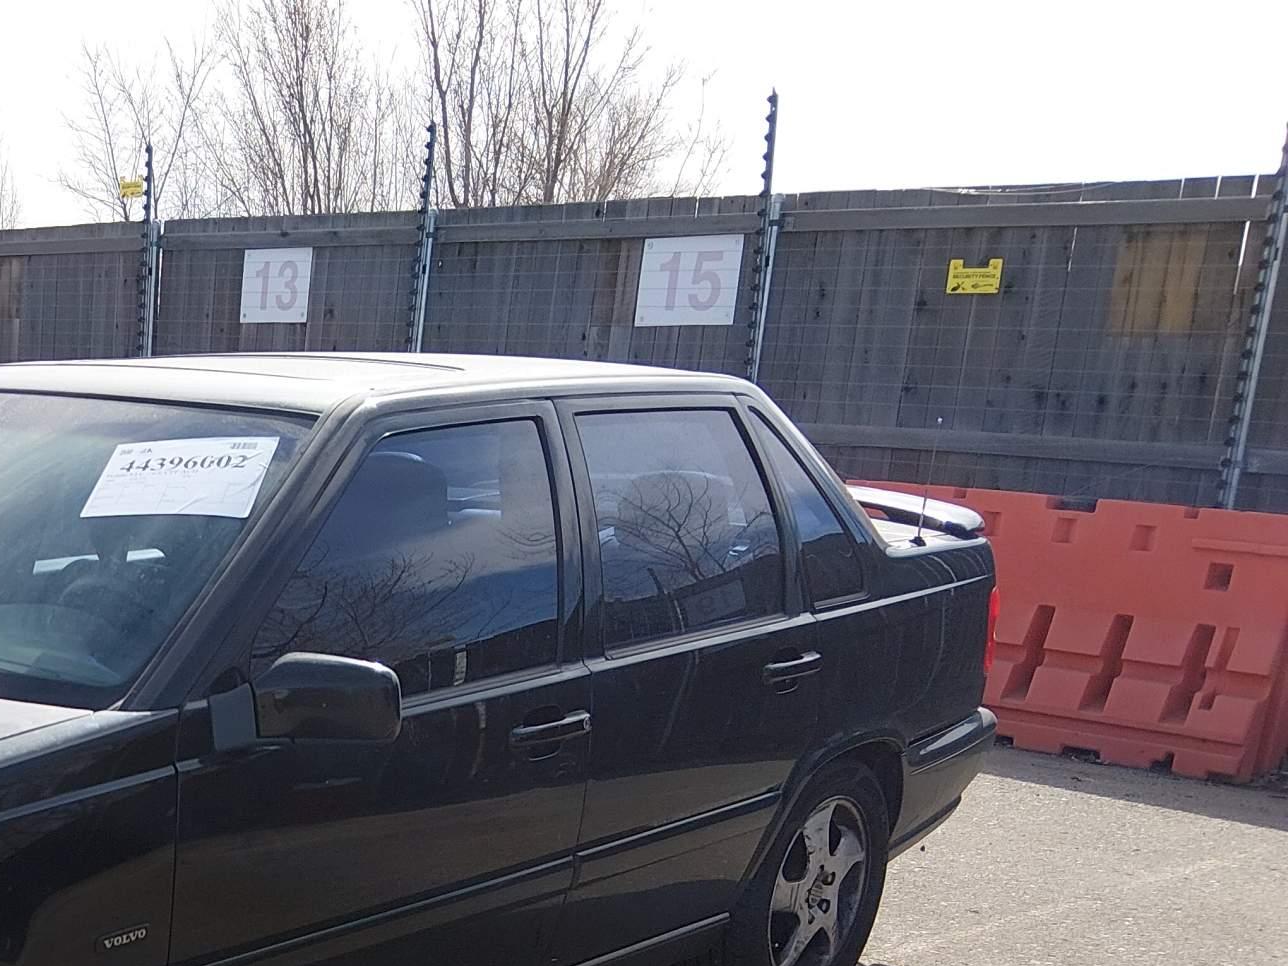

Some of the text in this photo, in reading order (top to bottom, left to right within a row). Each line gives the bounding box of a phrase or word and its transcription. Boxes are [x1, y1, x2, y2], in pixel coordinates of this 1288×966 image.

[255, 260, 299, 312] 13
[659, 250, 724, 312] 15
[103, 928, 147, 949] VOLVO
